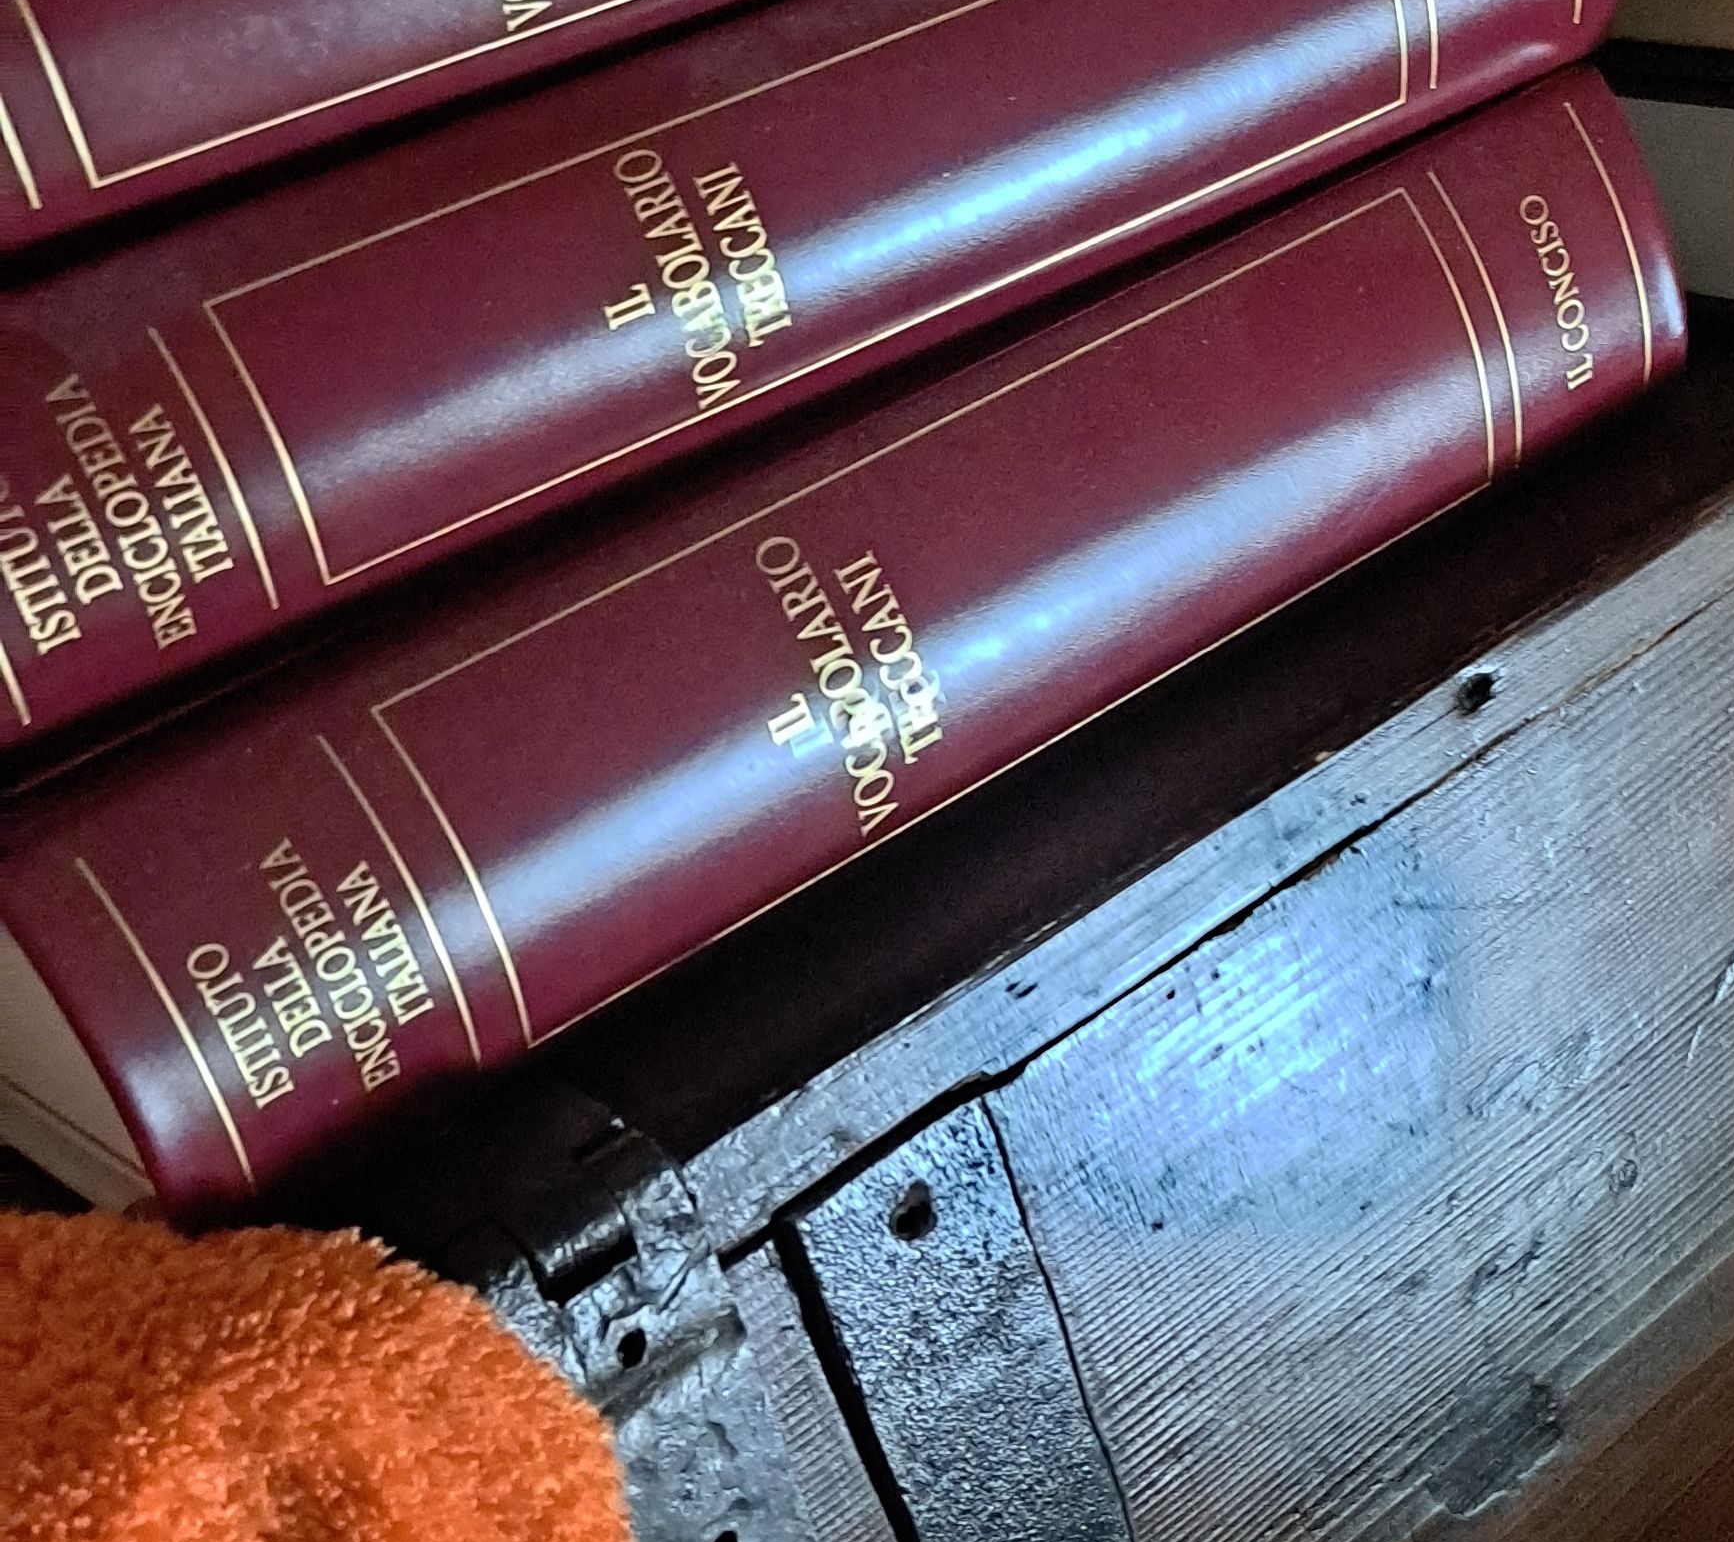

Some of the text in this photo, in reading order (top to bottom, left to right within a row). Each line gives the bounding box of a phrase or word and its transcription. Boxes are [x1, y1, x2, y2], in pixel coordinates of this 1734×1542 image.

[604, 282, 656, 331] IL
[613, 148, 742, 410] VOCABOLARIO
[693, 161, 793, 348] TRECCANI
[1518, 194, 1594, 353] CONCISO
[34, 472, 125, 606] DELLA
[45, 371, 198, 650] ENCICLOPEDIA
[128, 402, 235, 584] ITALIANA
[767, 692, 816, 747] IL
[186, 942, 295, 1110] ISTITUTO
[252, 934, 334, 1060] DELLA
[258, 836, 402, 1093] ENCICLOPEDIA
[336, 860, 436, 1027] ITALIANA
